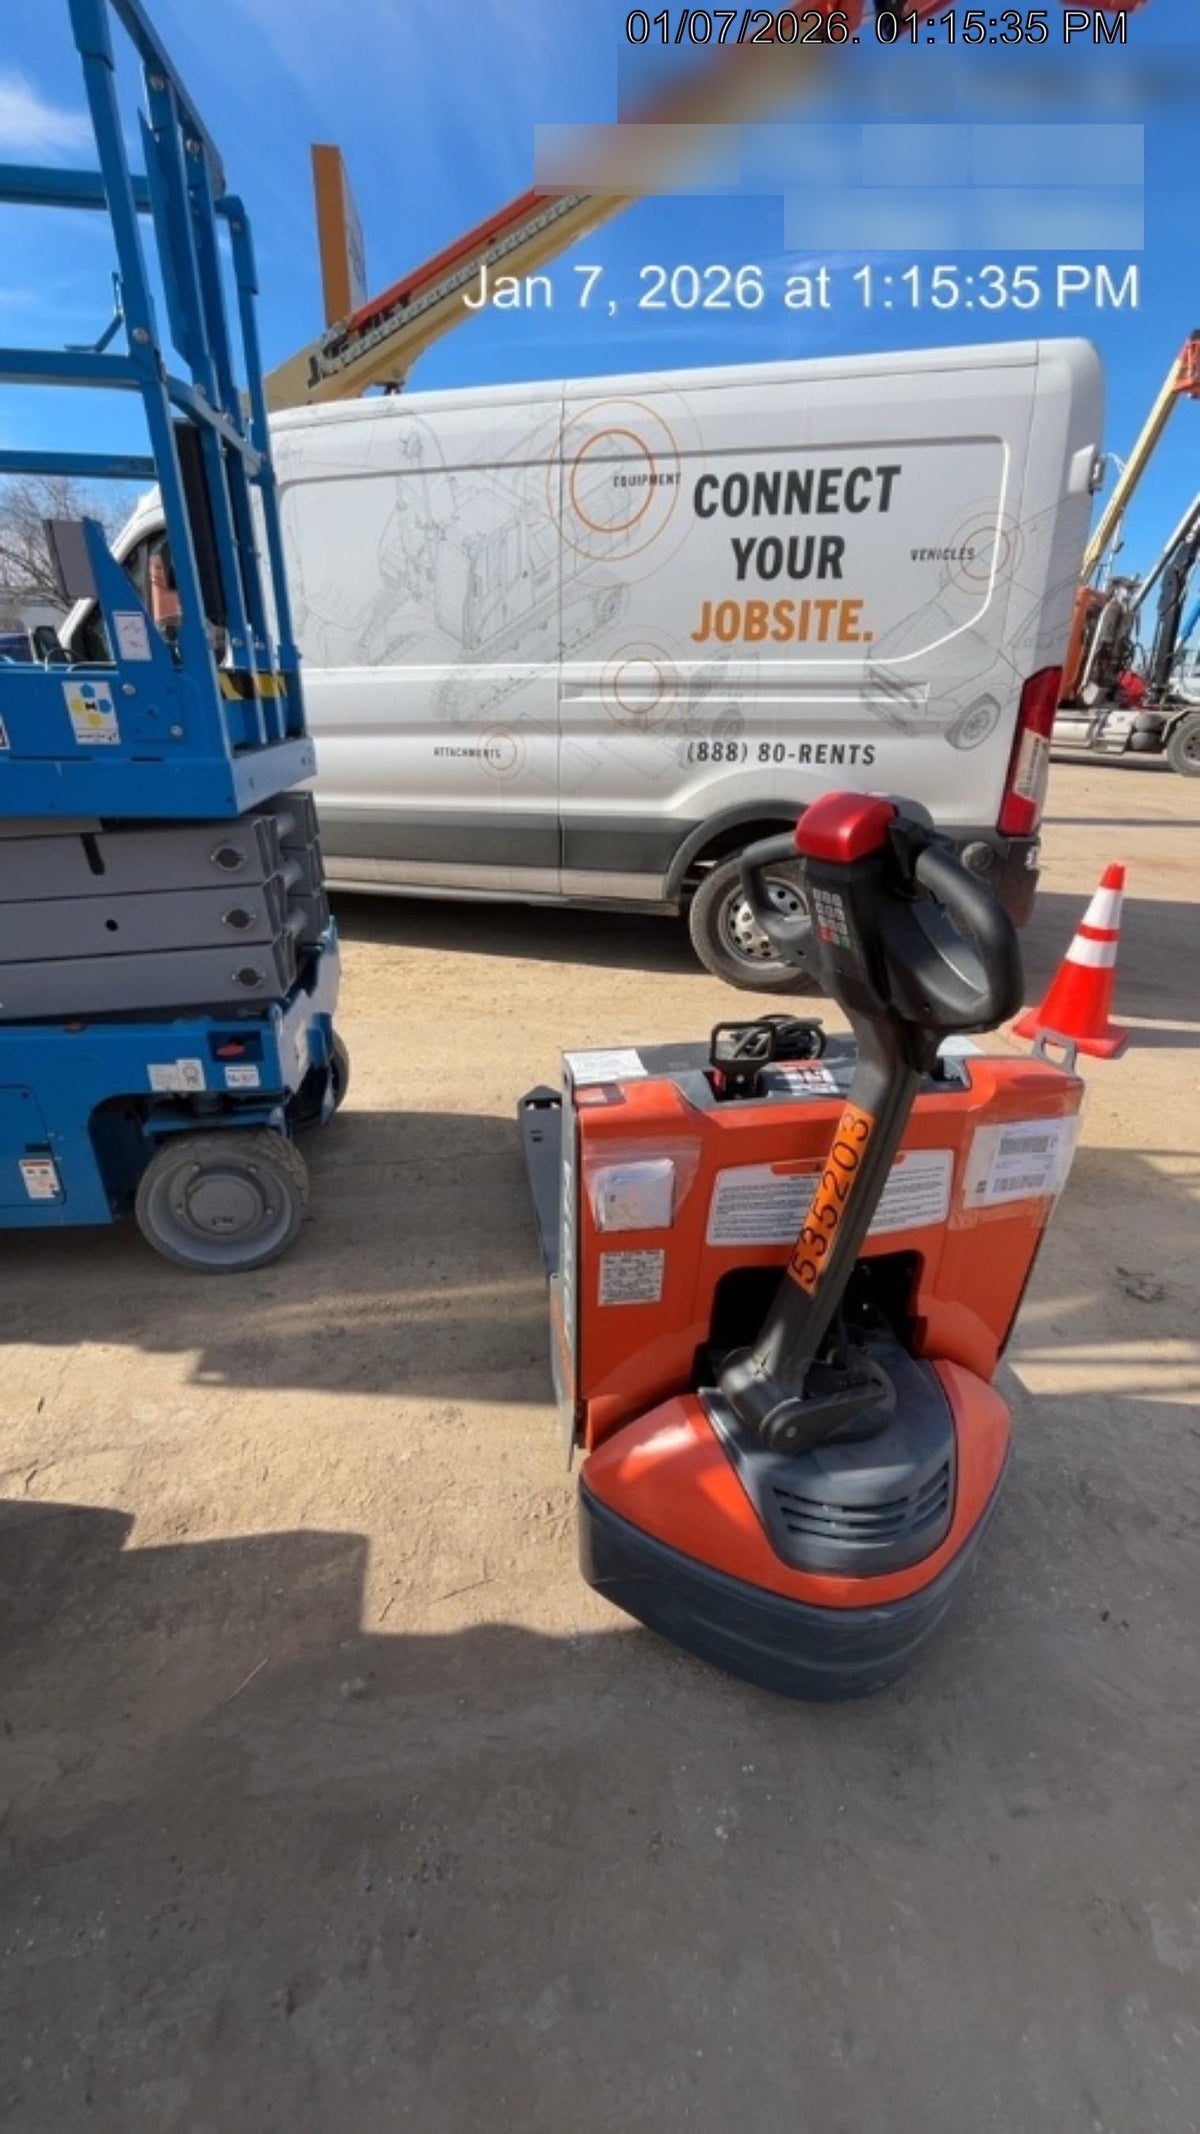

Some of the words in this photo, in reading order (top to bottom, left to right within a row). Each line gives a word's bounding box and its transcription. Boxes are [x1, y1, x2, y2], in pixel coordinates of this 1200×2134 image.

[613, 472, 682, 488] EQUIPMENT
[694, 465, 902, 518] CONNECT
[731, 535, 845, 580] YOUR
[910, 547, 976, 562] VEHICLES
[690, 599, 874, 642] JOBSITE.
[433, 746, 502, 759] ATTACHMENTS
[687, 741, 748, 764] (888)
[758, 742, 876, 765] 80-RENTS
[791, 1113, 869, 1285] 535203
